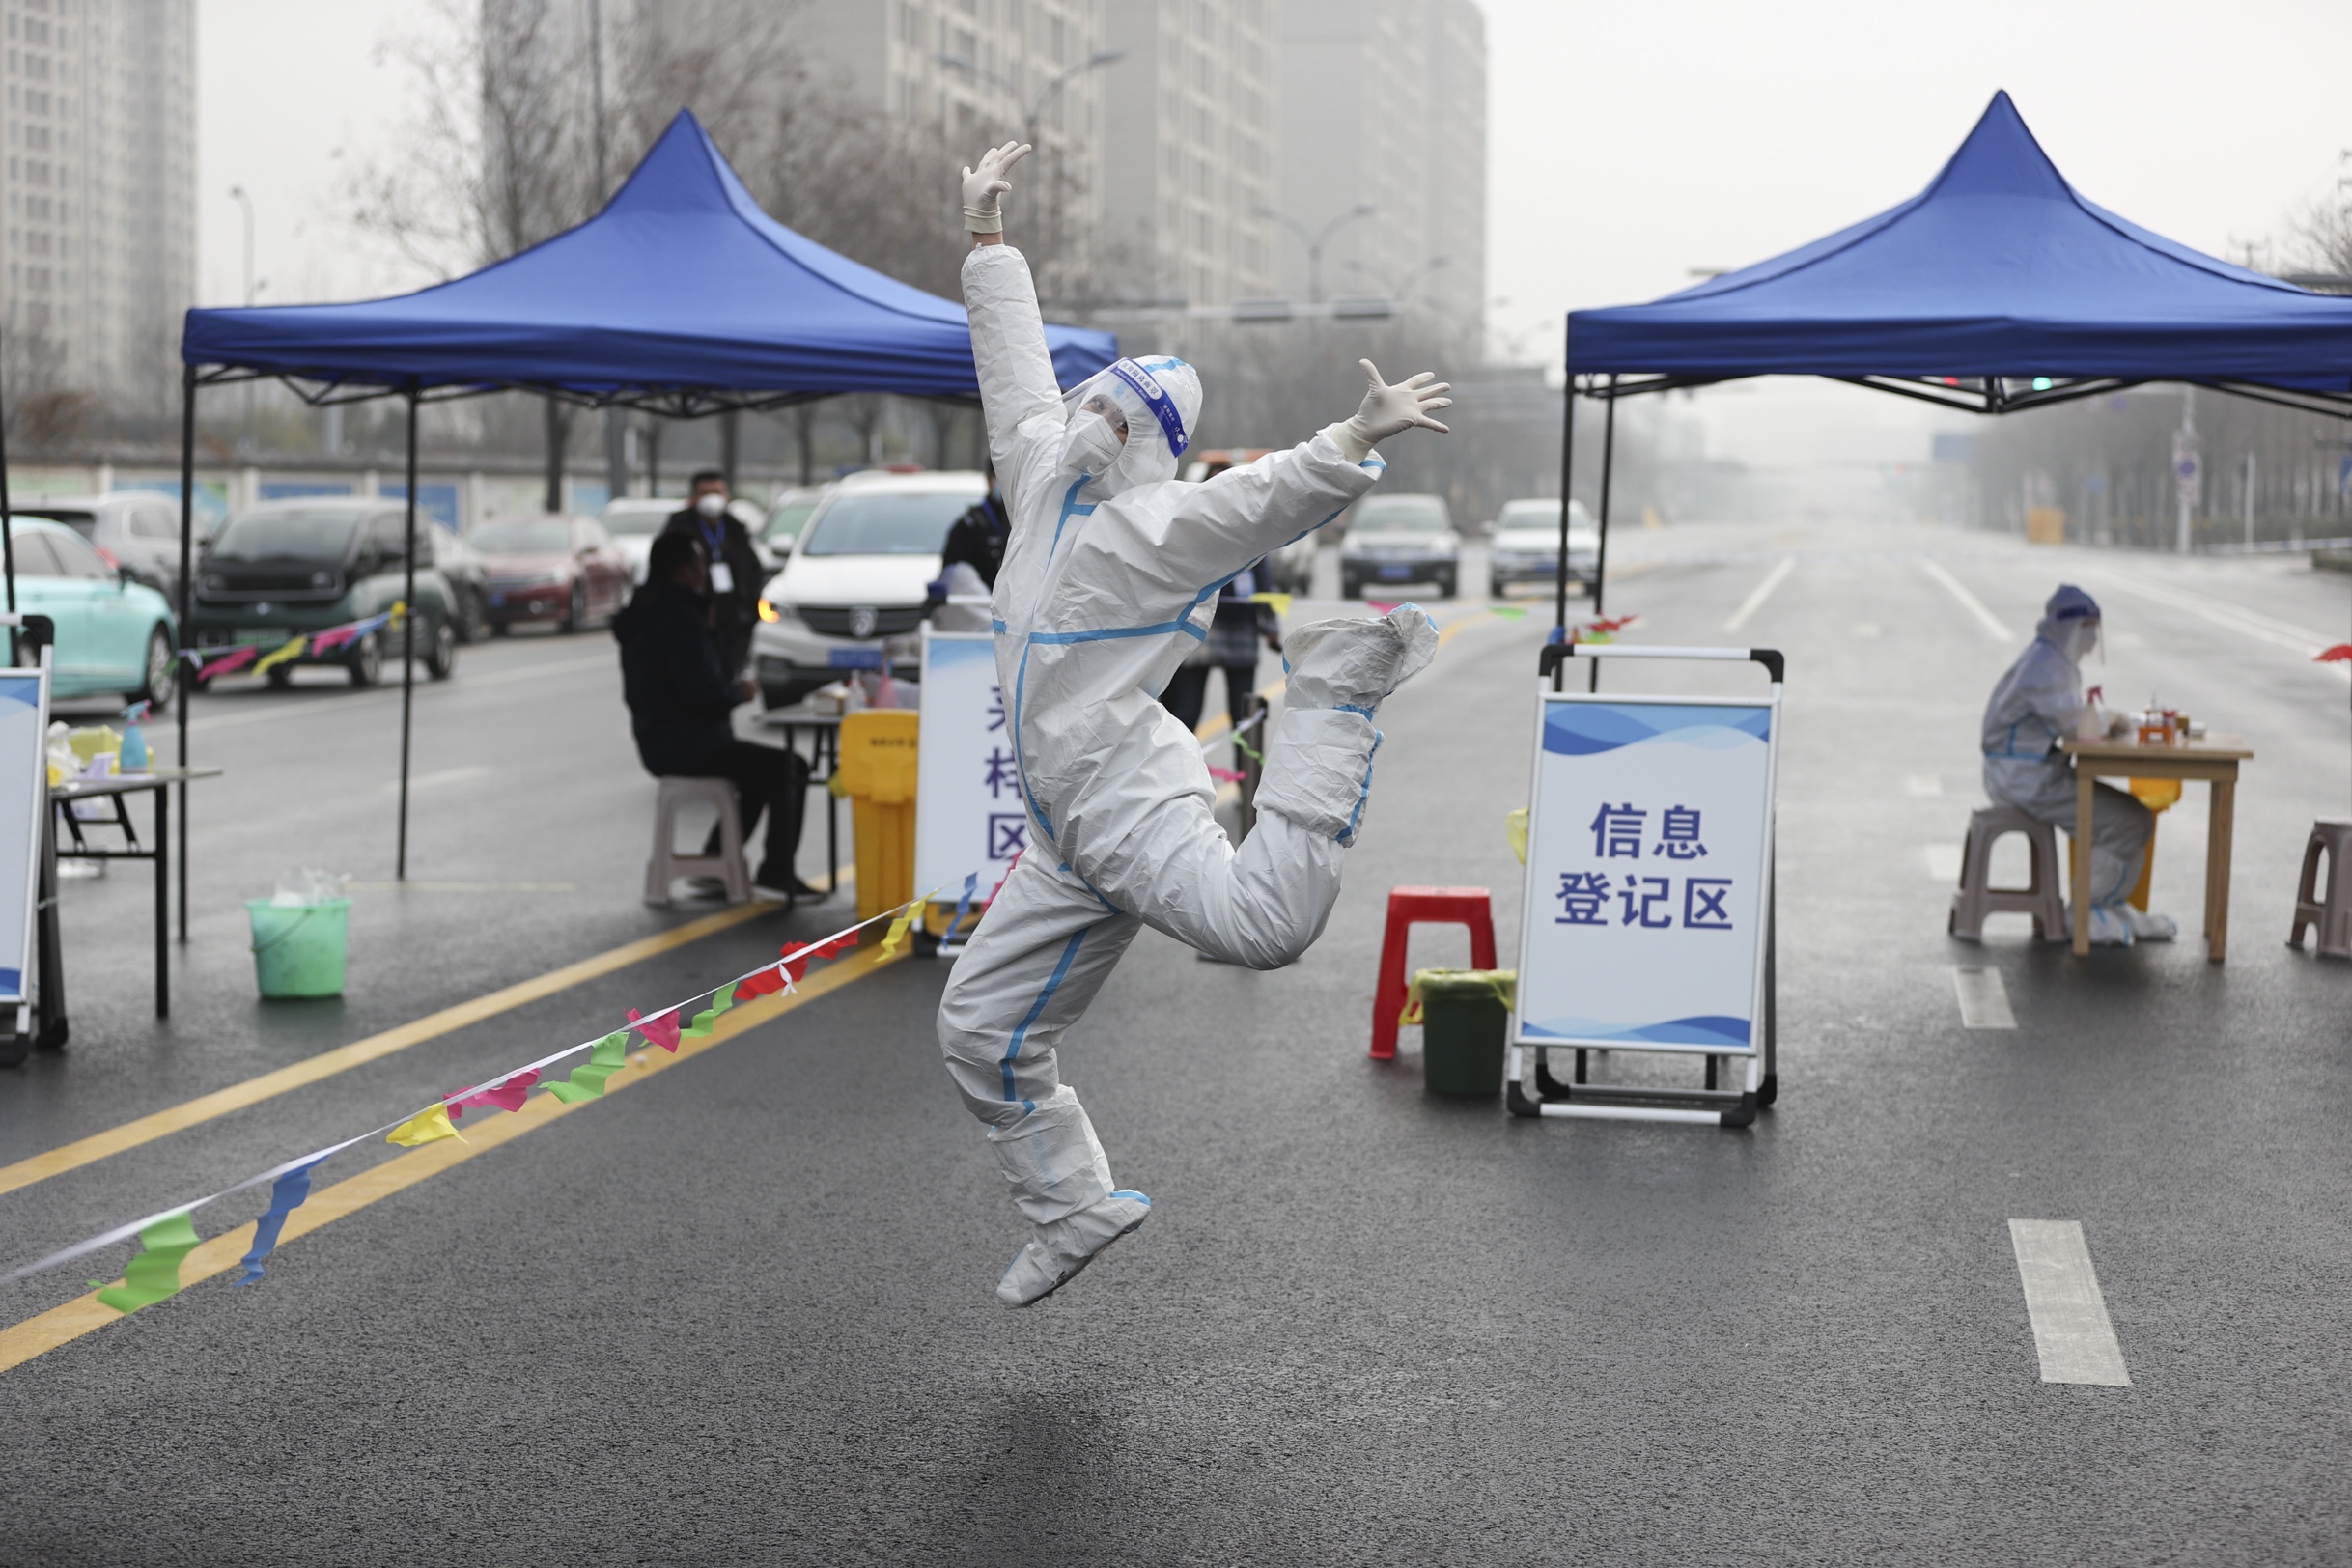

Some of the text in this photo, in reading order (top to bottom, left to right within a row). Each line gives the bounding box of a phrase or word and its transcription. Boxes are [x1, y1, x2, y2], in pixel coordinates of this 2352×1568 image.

[1589, 802, 1708, 860] 信息
[1554, 872, 1733, 930] 登记区
